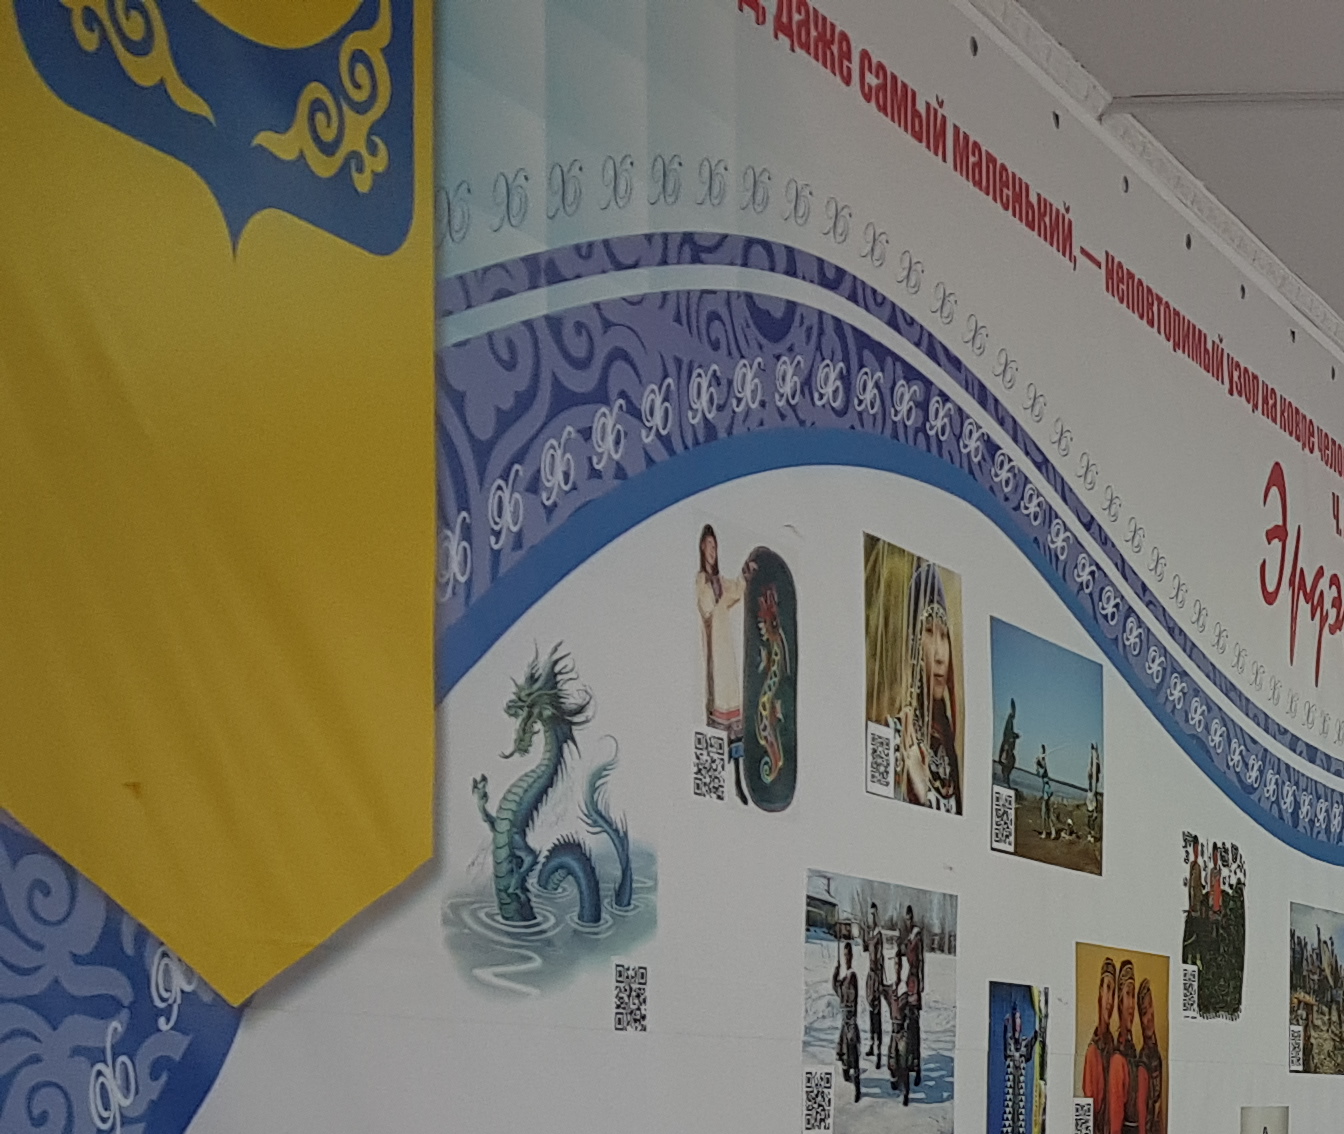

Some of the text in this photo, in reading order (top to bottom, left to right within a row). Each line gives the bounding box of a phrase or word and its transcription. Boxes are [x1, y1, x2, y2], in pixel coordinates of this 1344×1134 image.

[773, 0, 852, 87] даже
[858, 48, 947, 164] самый
[952, 122, 1077, 271] маленький,
[1105, 250, 1225, 385] неповторимый
[1226, 352, 1260, 413] узор
[1261, 379, 1278, 426] на
[1279, 393, 1315, 454] ковре
